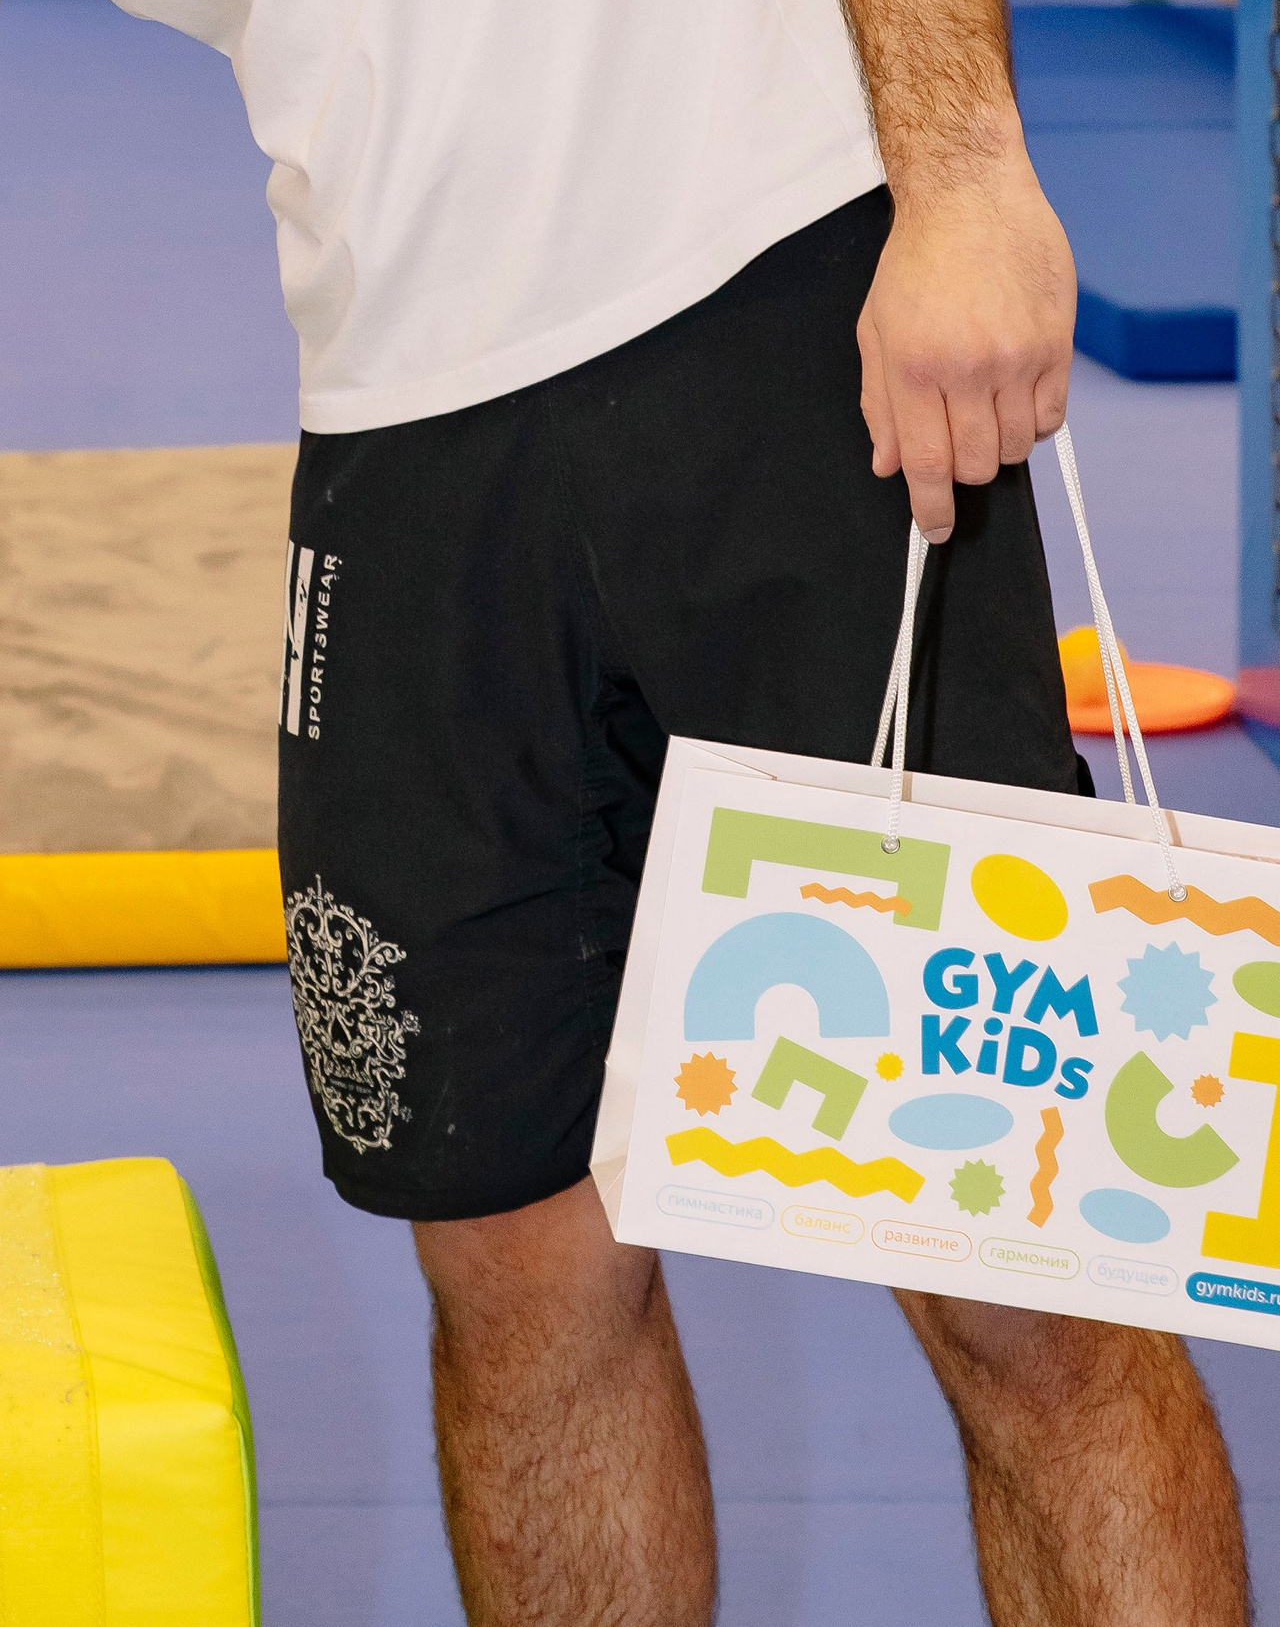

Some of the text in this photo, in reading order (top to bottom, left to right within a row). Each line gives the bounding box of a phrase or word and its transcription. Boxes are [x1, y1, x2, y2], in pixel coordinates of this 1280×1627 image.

[922, 946, 1100, 1038] GYM
[668, 1193, 763, 1220] гимнастика
[794, 1212, 852, 1235] баланс
[883, 1228, 960, 1252] развитие
[989, 1245, 1069, 1270] гармония
[1097, 1261, 1168, 1286] будущее
